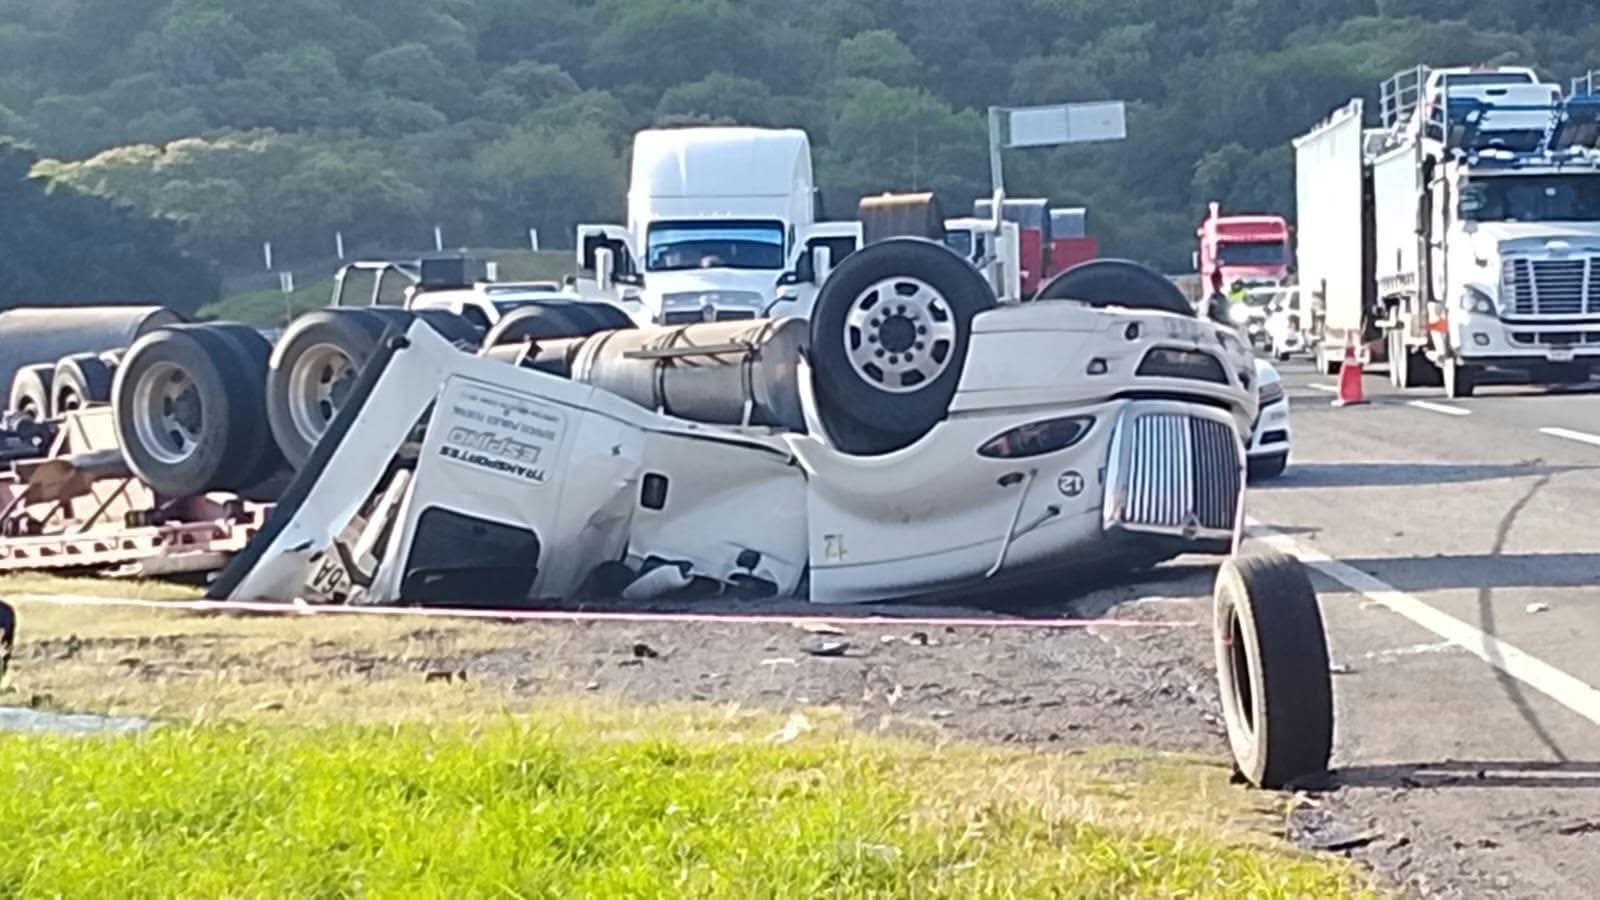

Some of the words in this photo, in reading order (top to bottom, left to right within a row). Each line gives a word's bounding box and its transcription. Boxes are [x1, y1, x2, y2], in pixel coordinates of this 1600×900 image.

[448, 426, 542, 464] ESPINO
[439, 445, 545, 481] TRANSPORTES
[1060, 475, 1081, 491] 12
[824, 534, 848, 560] 12
